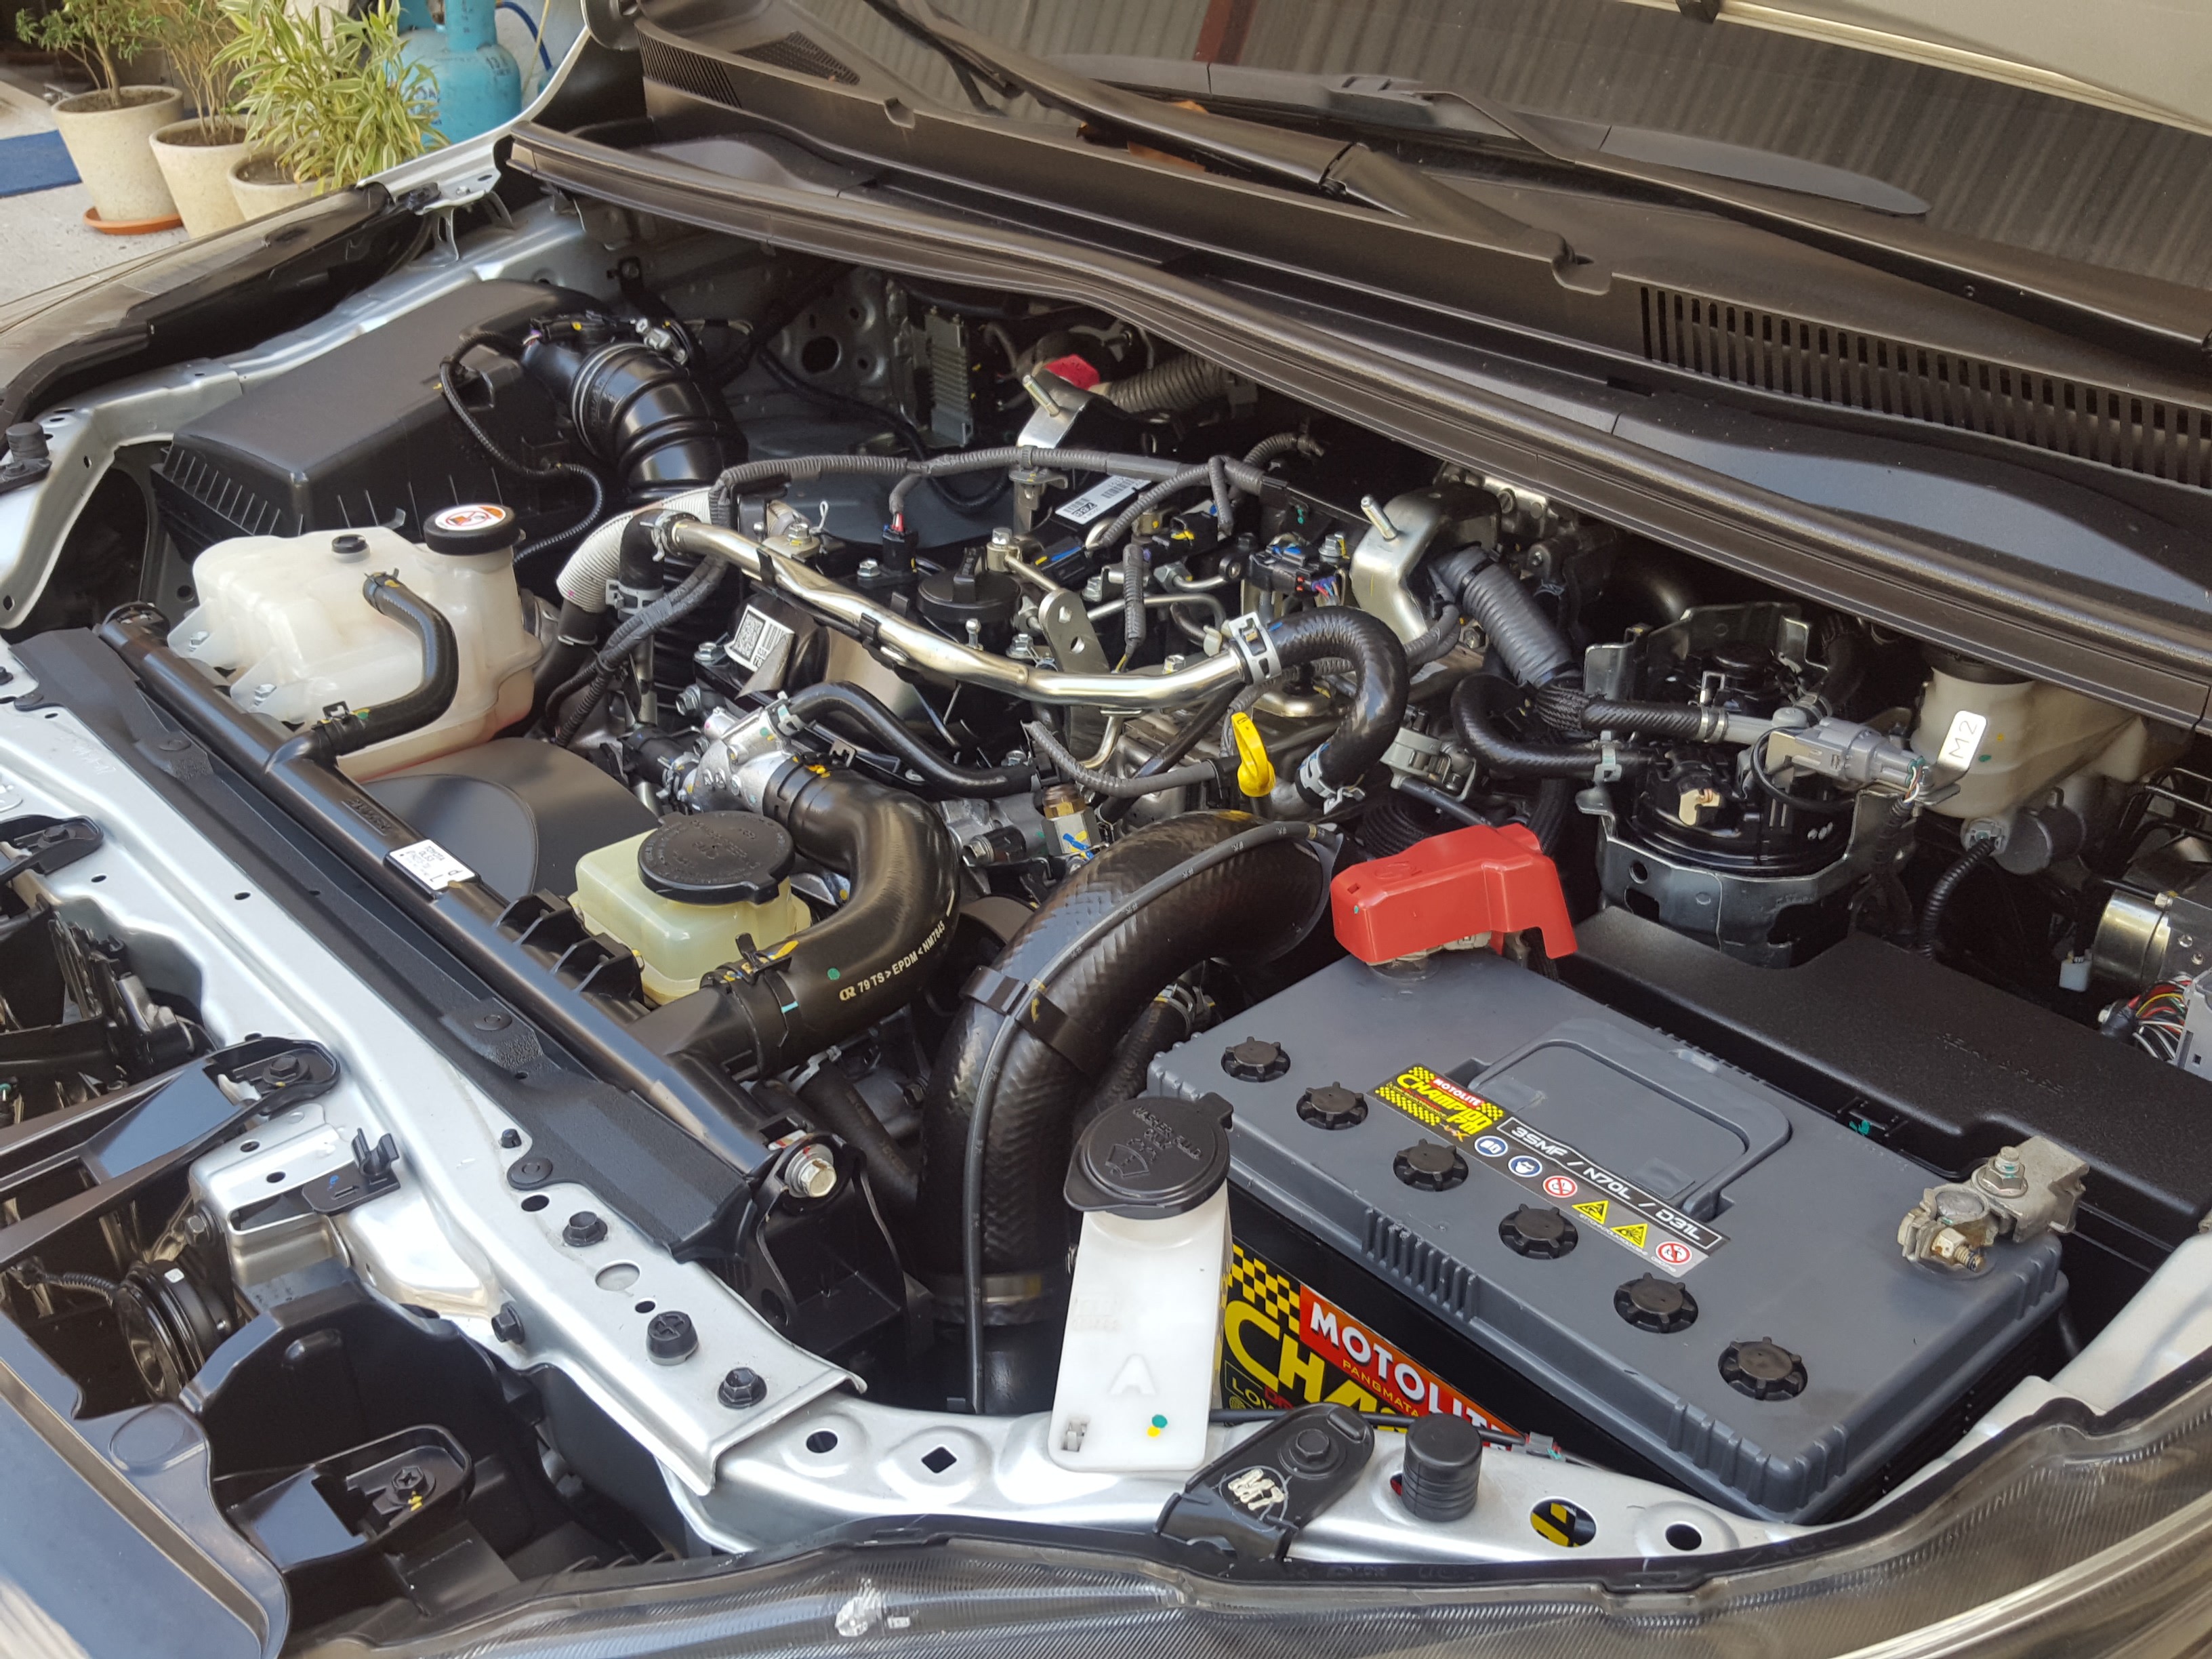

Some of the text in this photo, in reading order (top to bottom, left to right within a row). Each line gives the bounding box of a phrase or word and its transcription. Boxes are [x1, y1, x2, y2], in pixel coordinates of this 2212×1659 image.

[1948, 720, 1978, 759] M2
[857, 979, 870, 994] 79
[869, 972, 885, 987] TS
[1397, 1073, 1493, 1126] CHAMPION
[1433, 1078, 1482, 1107] MOTOLITE
[1511, 1126, 1568, 1158] 3SMF
[1582, 1167, 1632, 1200] N70L
[1655, 1208, 1701, 1240] D31L
[1224, 1300, 1408, 1433] CHA
[1311, 1300, 1507, 1450] MOTOLIT
